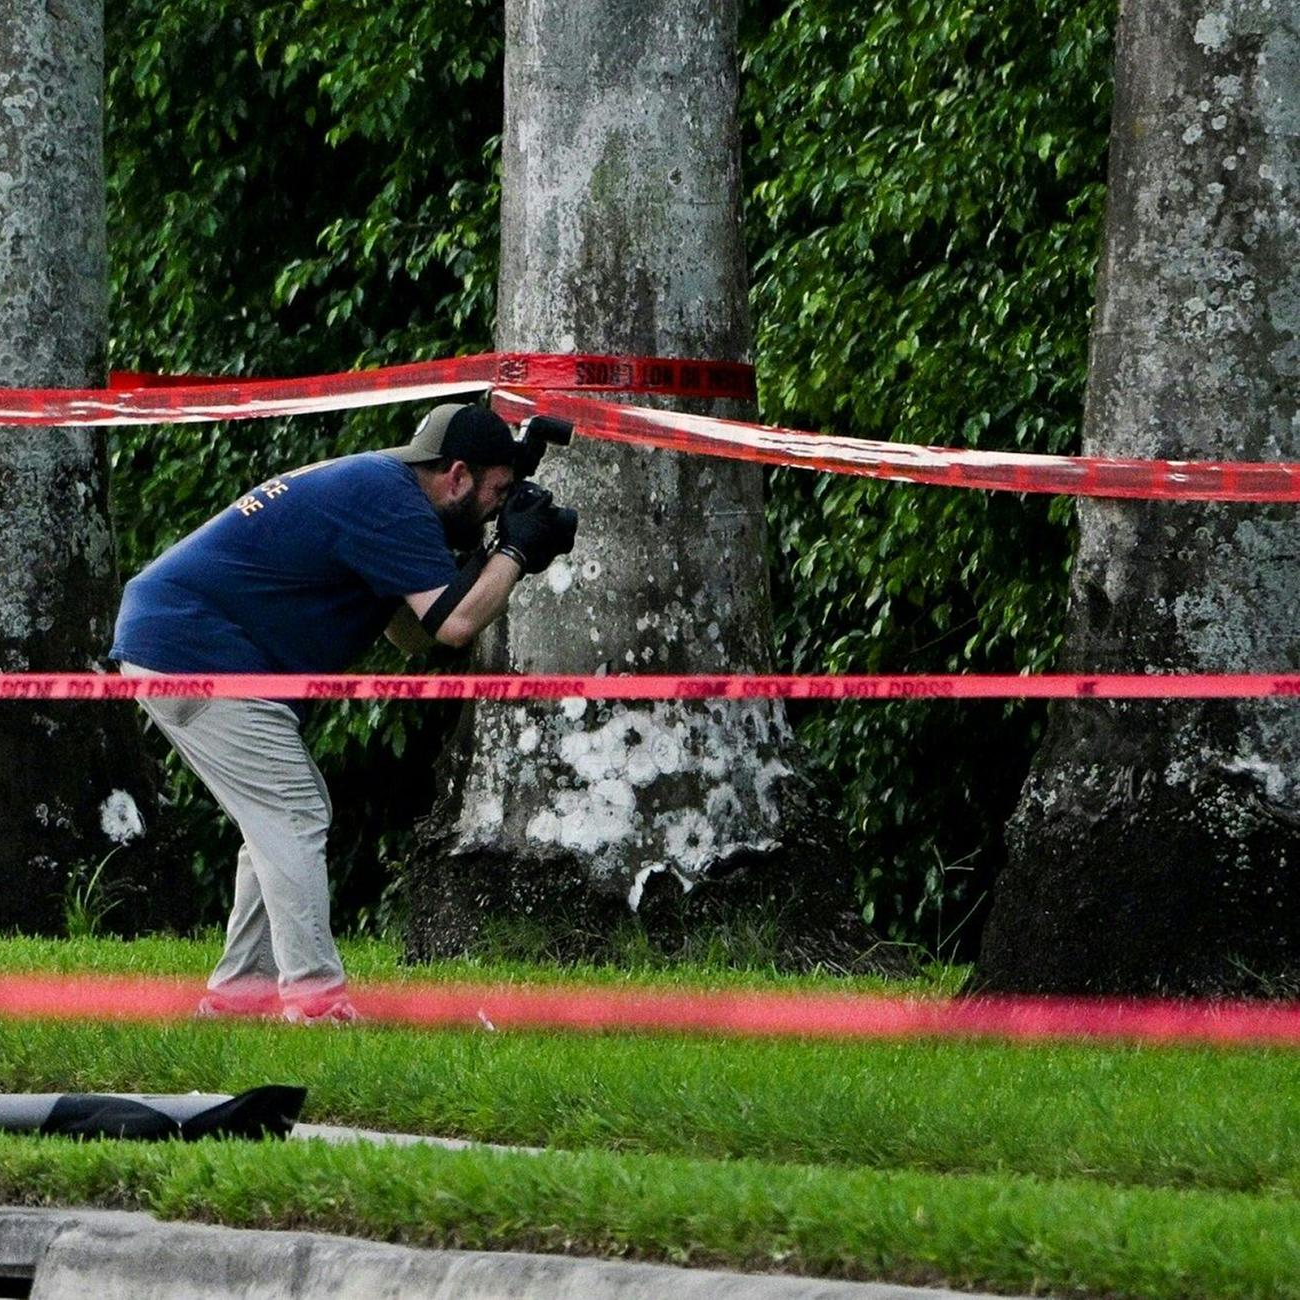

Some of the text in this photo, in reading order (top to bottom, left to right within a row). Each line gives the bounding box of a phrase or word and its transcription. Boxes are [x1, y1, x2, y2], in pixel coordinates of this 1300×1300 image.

[1, 680, 57, 697] SCENE
[66, 680, 94, 697] DO
[102, 680, 142, 697] NOT
[148, 680, 215, 697] CROSS
[372, 681, 428, 698] SCENE
[437, 681, 465, 698] DO
[473, 681, 513, 698] NOT
[519, 681, 586, 698] CROSS
